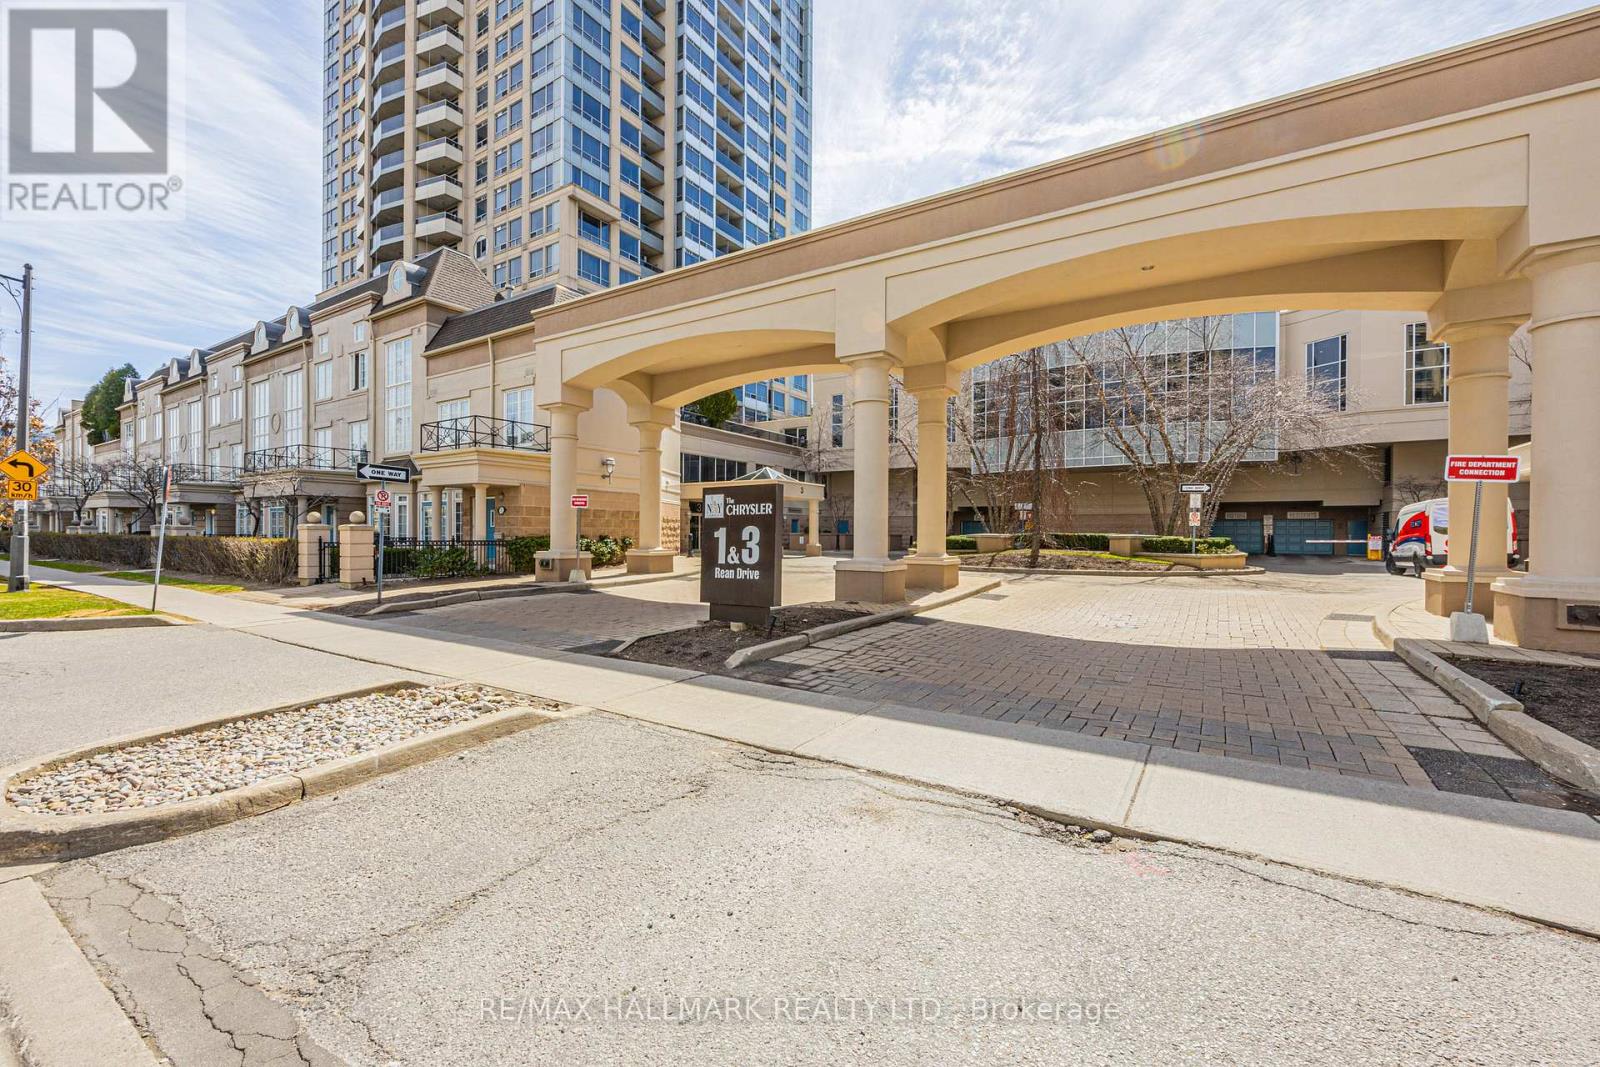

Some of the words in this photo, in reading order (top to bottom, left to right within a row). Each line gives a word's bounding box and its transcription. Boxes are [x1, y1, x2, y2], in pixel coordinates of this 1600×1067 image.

[1468, 461, 1516, 469] DEPARTMENT
[12, 481, 32, 492] 30
[725, 503, 773, 516] CHRYSLER
[714, 567, 735, 579] Rean
[736, 567, 760, 580] Drive
